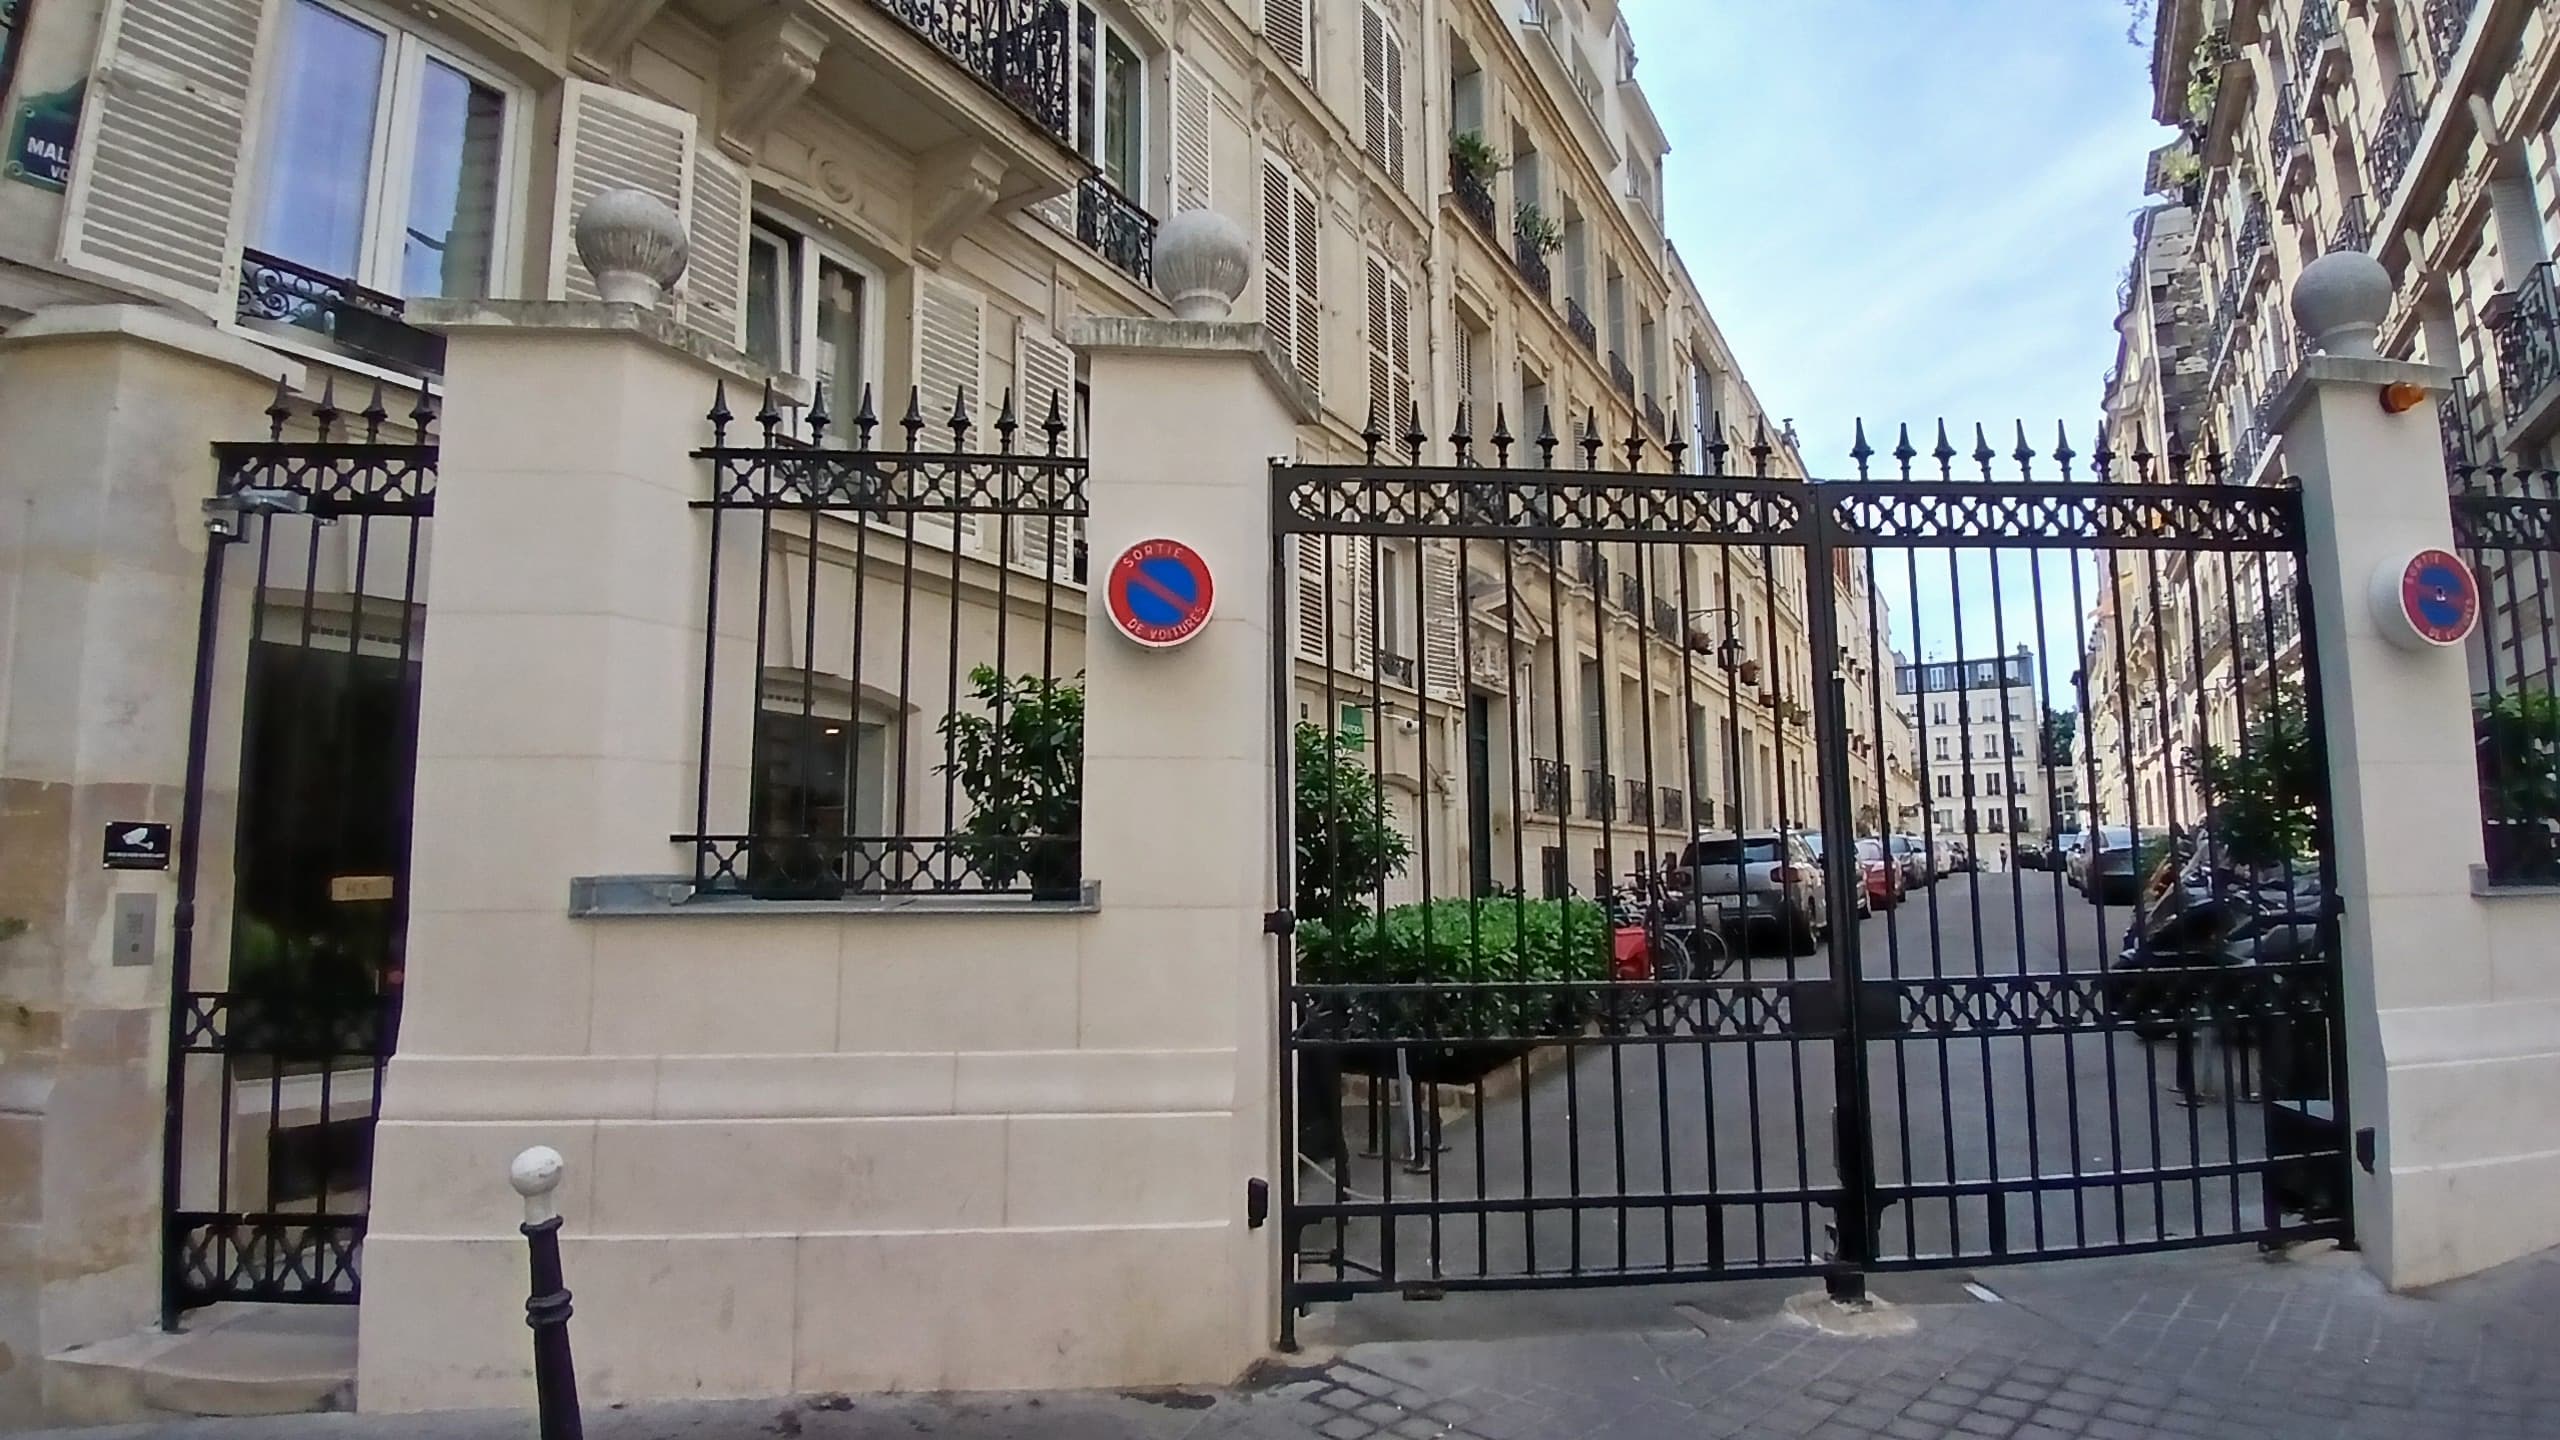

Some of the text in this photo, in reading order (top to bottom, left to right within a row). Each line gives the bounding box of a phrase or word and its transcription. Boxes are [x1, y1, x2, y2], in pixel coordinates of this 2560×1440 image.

[1123, 543, 1183, 568] SORTIE
[1127, 607, 1206, 640] DE VOITURES
